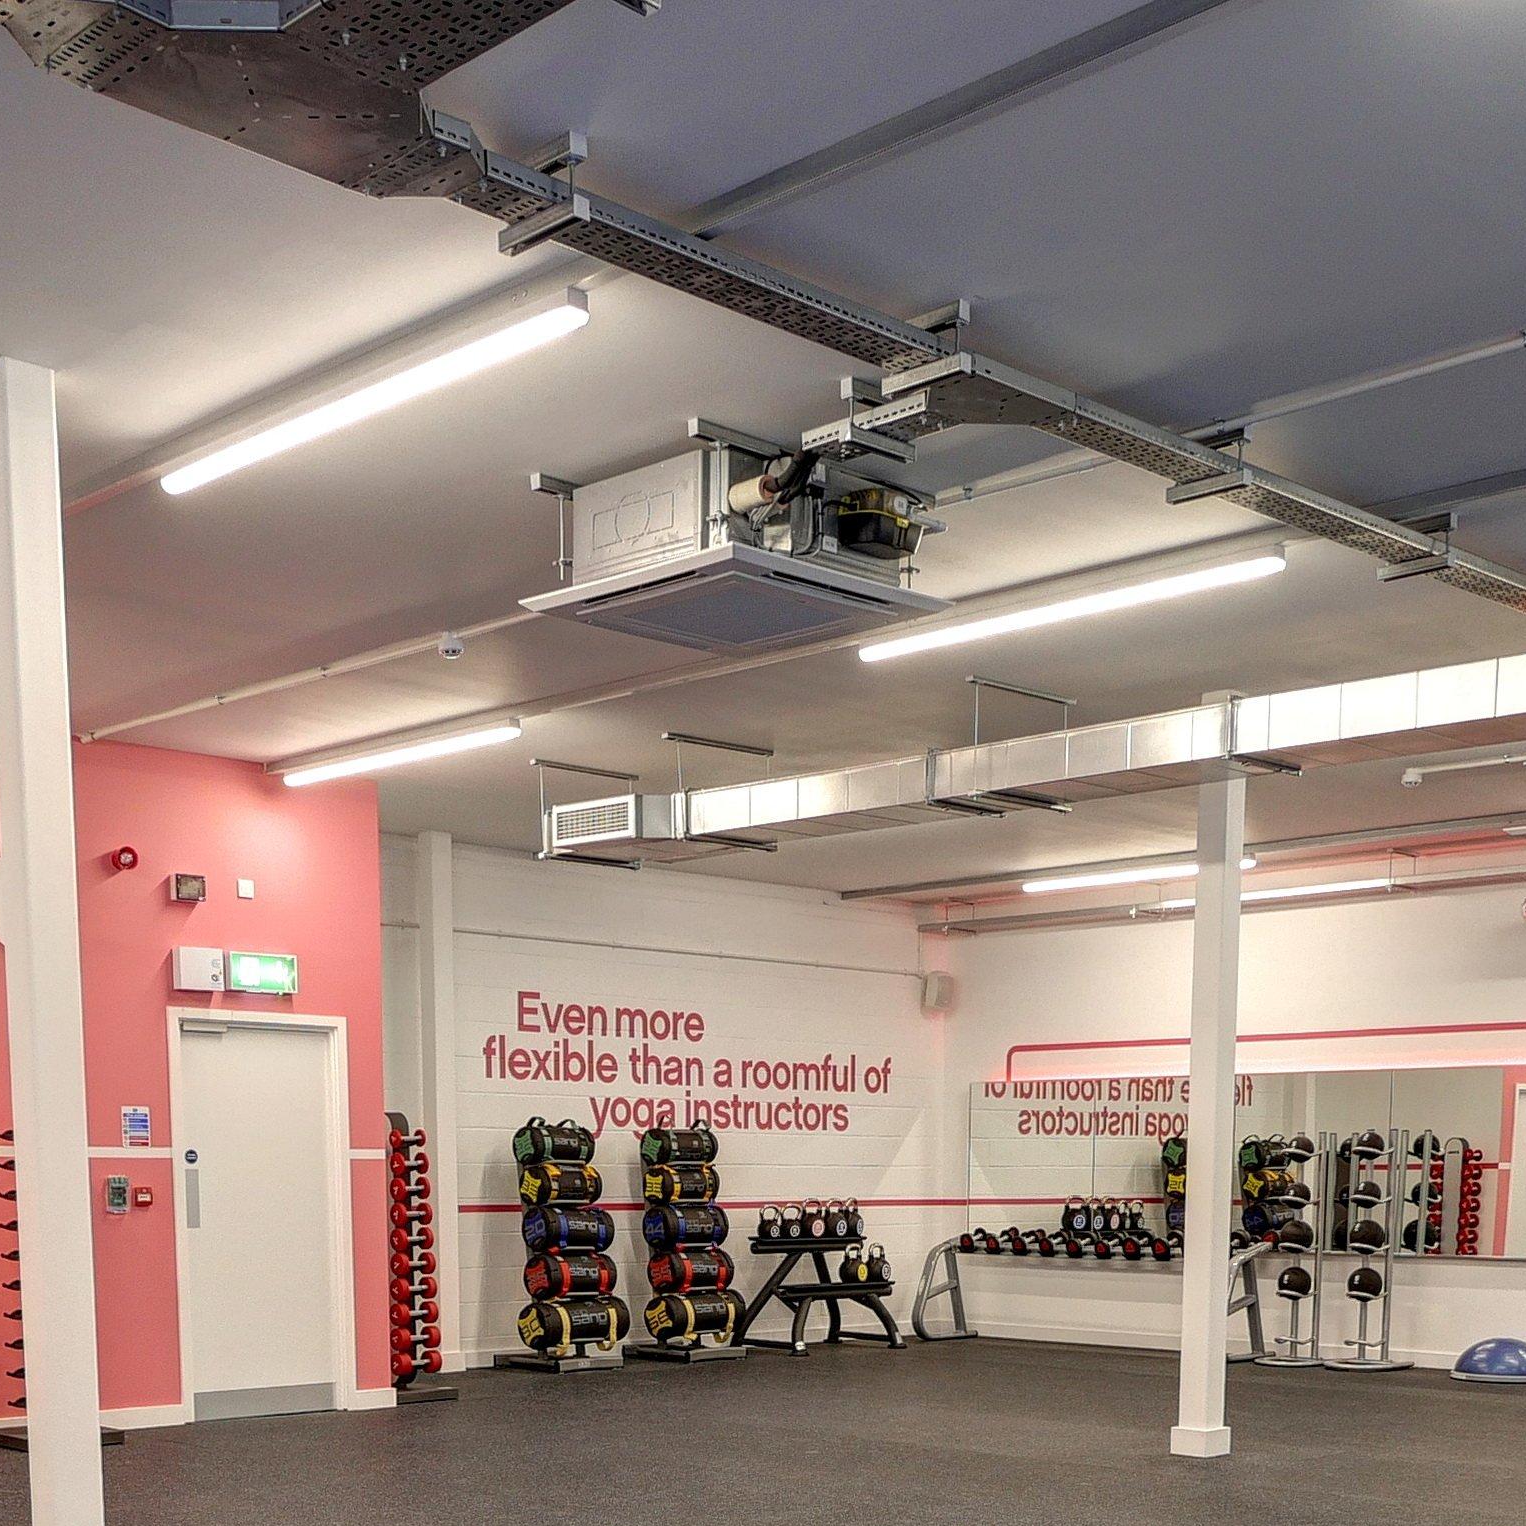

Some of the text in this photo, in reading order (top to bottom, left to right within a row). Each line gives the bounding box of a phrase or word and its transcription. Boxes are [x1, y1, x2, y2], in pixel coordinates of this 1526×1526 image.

[517, 991, 705, 1042] Even more
[483, 1034, 892, 1094] flexible than a roomful of
[589, 1090, 849, 1140] yoga instructors
